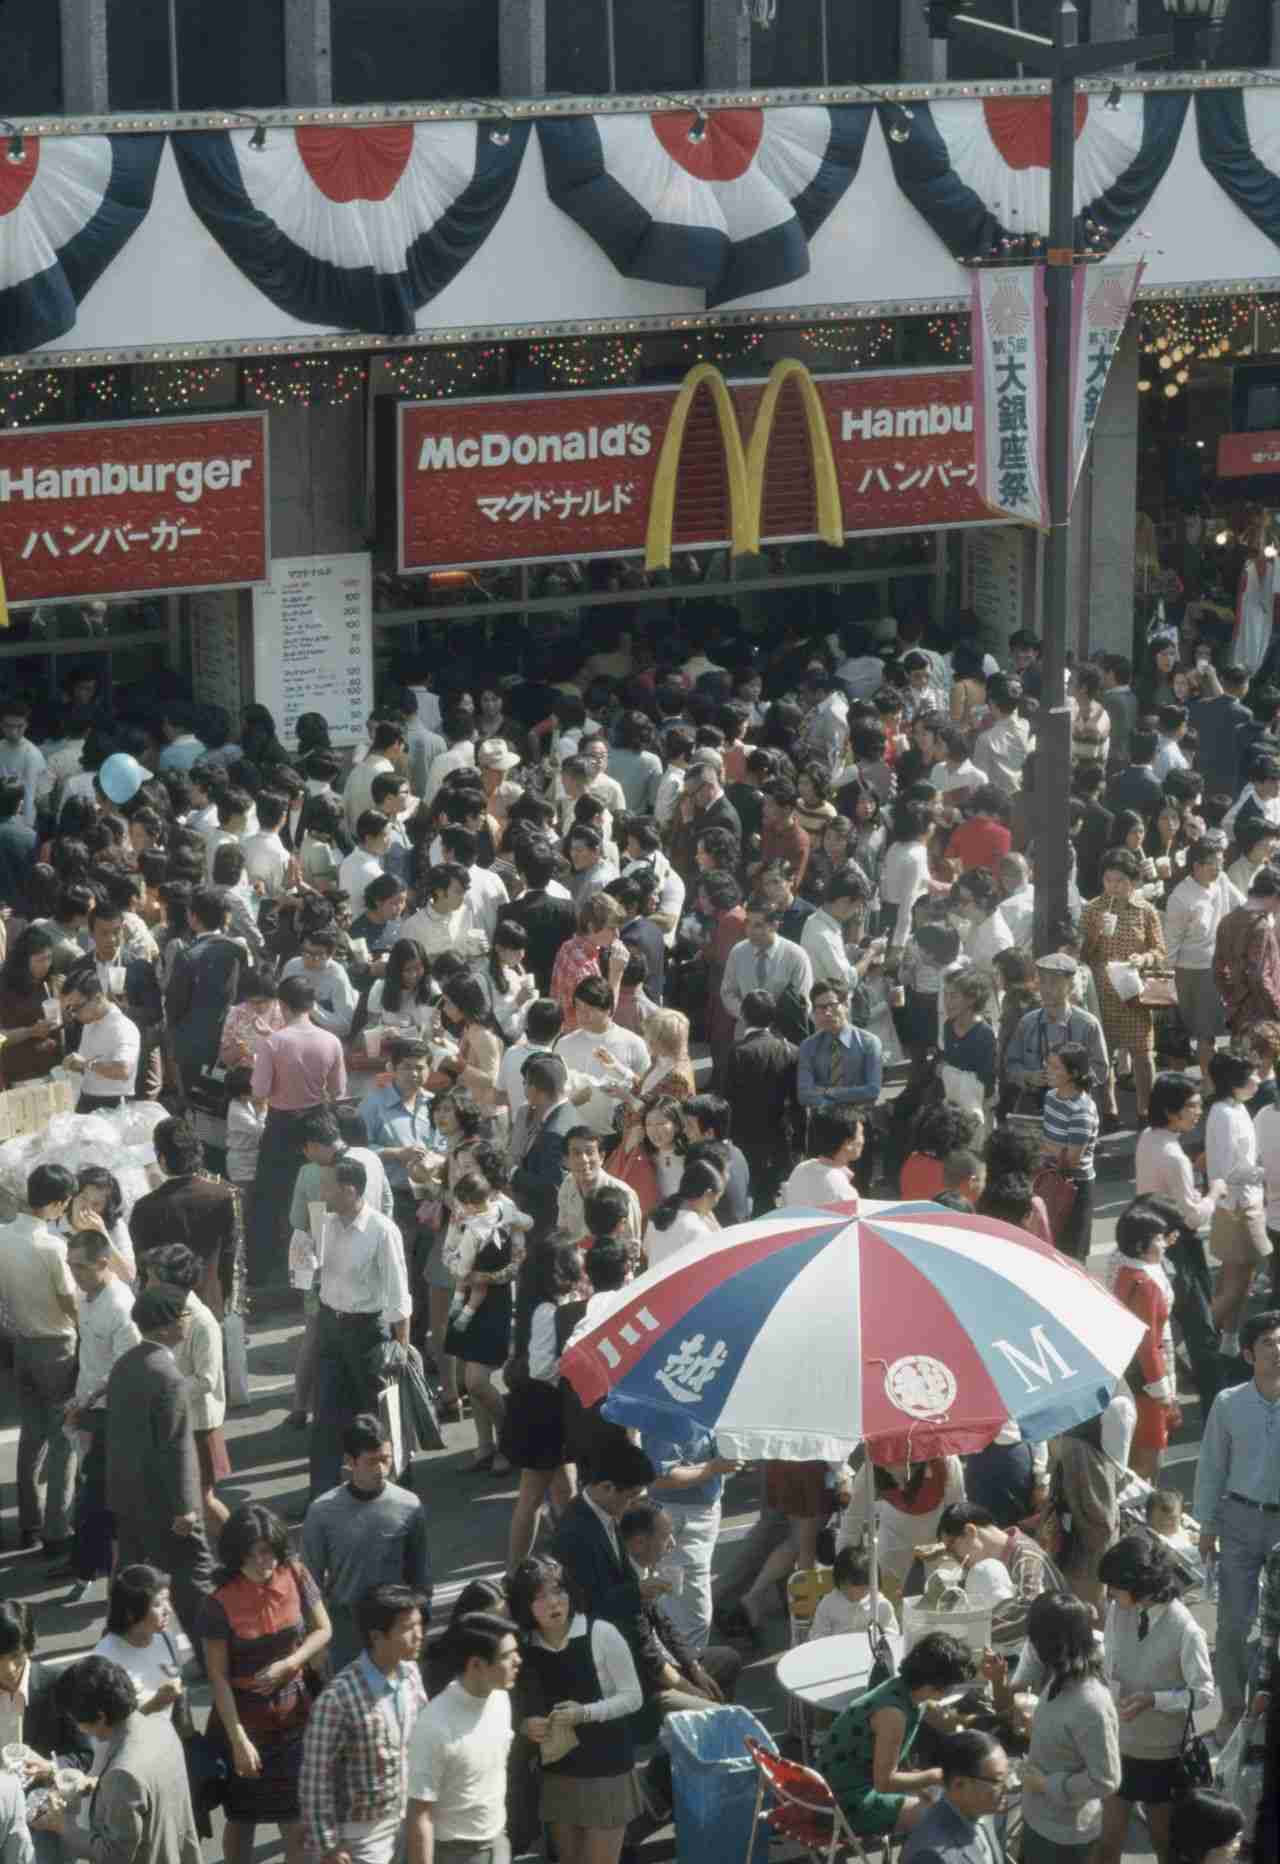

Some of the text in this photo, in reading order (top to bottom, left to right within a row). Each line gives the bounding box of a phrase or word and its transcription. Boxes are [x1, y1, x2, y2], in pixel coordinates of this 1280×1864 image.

[841, 403, 975, 441] Hambu
[996, 356, 1029, 507] 大銀座祭
[418, 422, 652, 471] McDonald's
[0, 457, 253, 503] Hamburger
[476, 482, 635, 523] マクドナルド
[20, 515, 202, 560] ハンバーガー
[991, 1323, 1080, 1393] M
